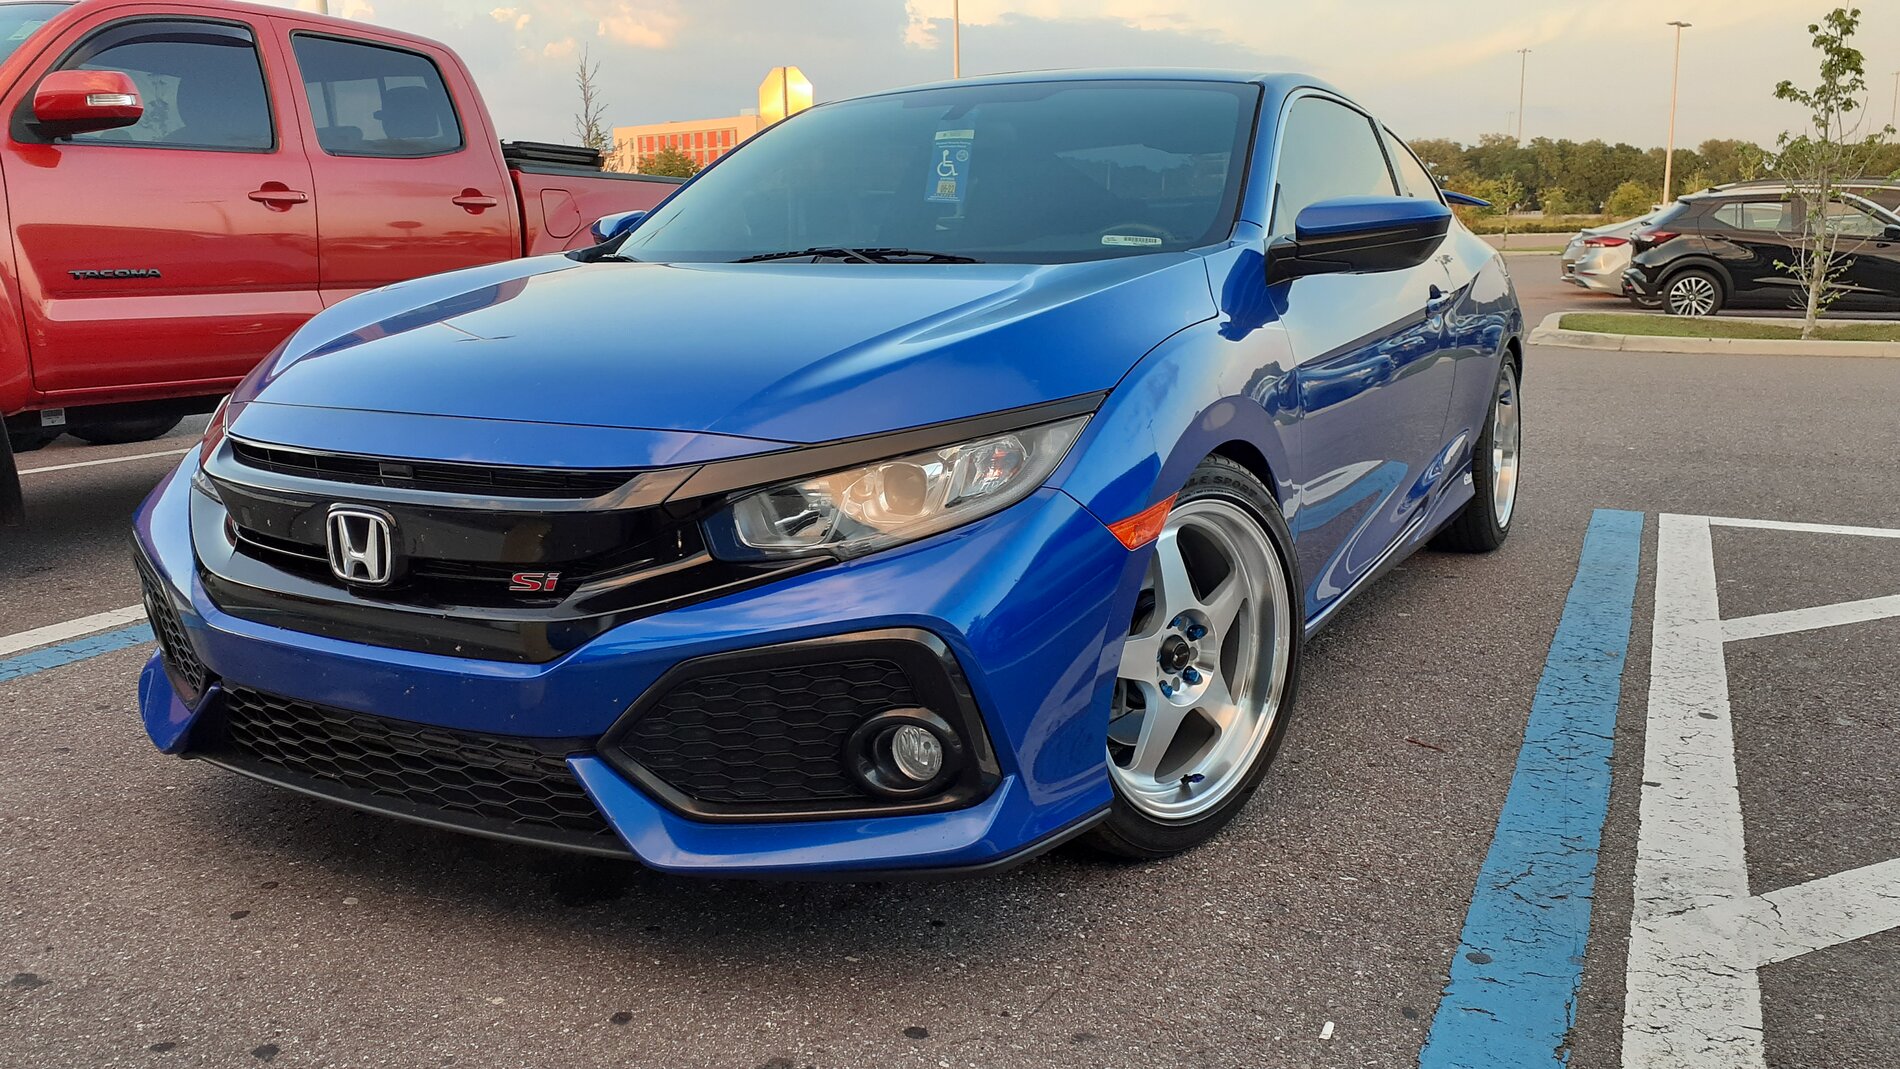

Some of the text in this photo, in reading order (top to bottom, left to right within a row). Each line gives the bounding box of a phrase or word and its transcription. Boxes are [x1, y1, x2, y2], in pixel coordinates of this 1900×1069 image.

[67, 268, 161, 280] TACOMA
[1212, 475, 1258, 497] SPORT
[509, 572, 561, 592] Si
